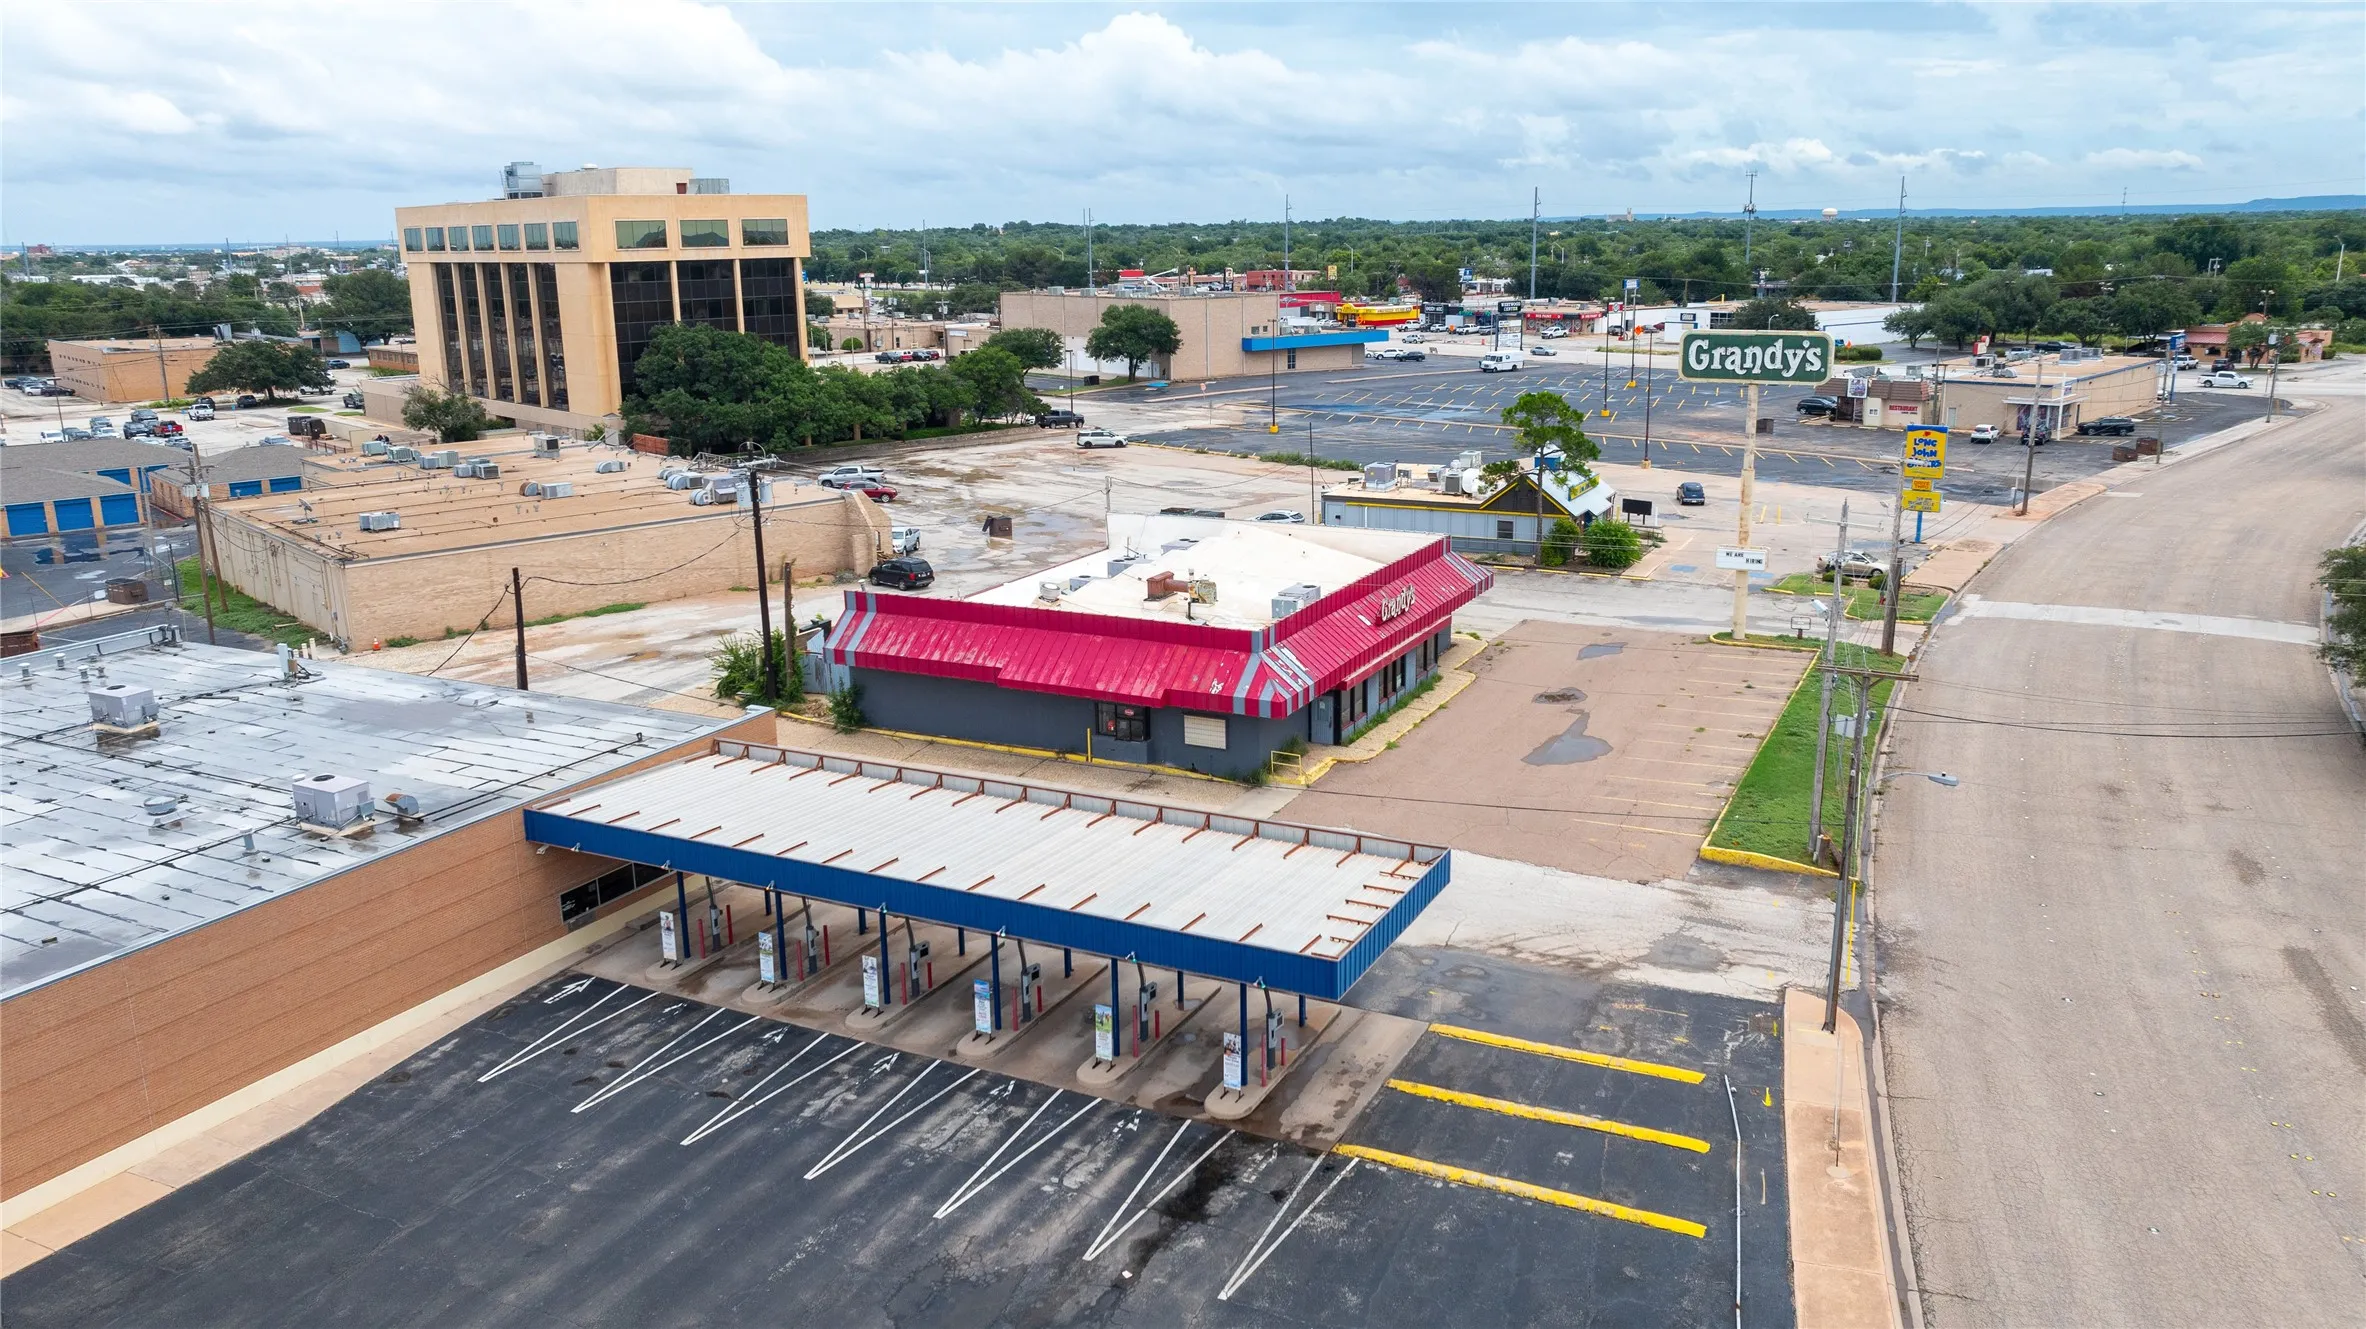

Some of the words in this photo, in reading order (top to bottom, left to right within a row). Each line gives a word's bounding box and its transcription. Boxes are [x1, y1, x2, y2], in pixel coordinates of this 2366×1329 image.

[1688, 338, 1822, 378] Grandy's
[1888, 404, 1919, 412] RESTAURANT
[1913, 438, 1938, 447] LONG
[1381, 583, 1415, 622] Grandy's
